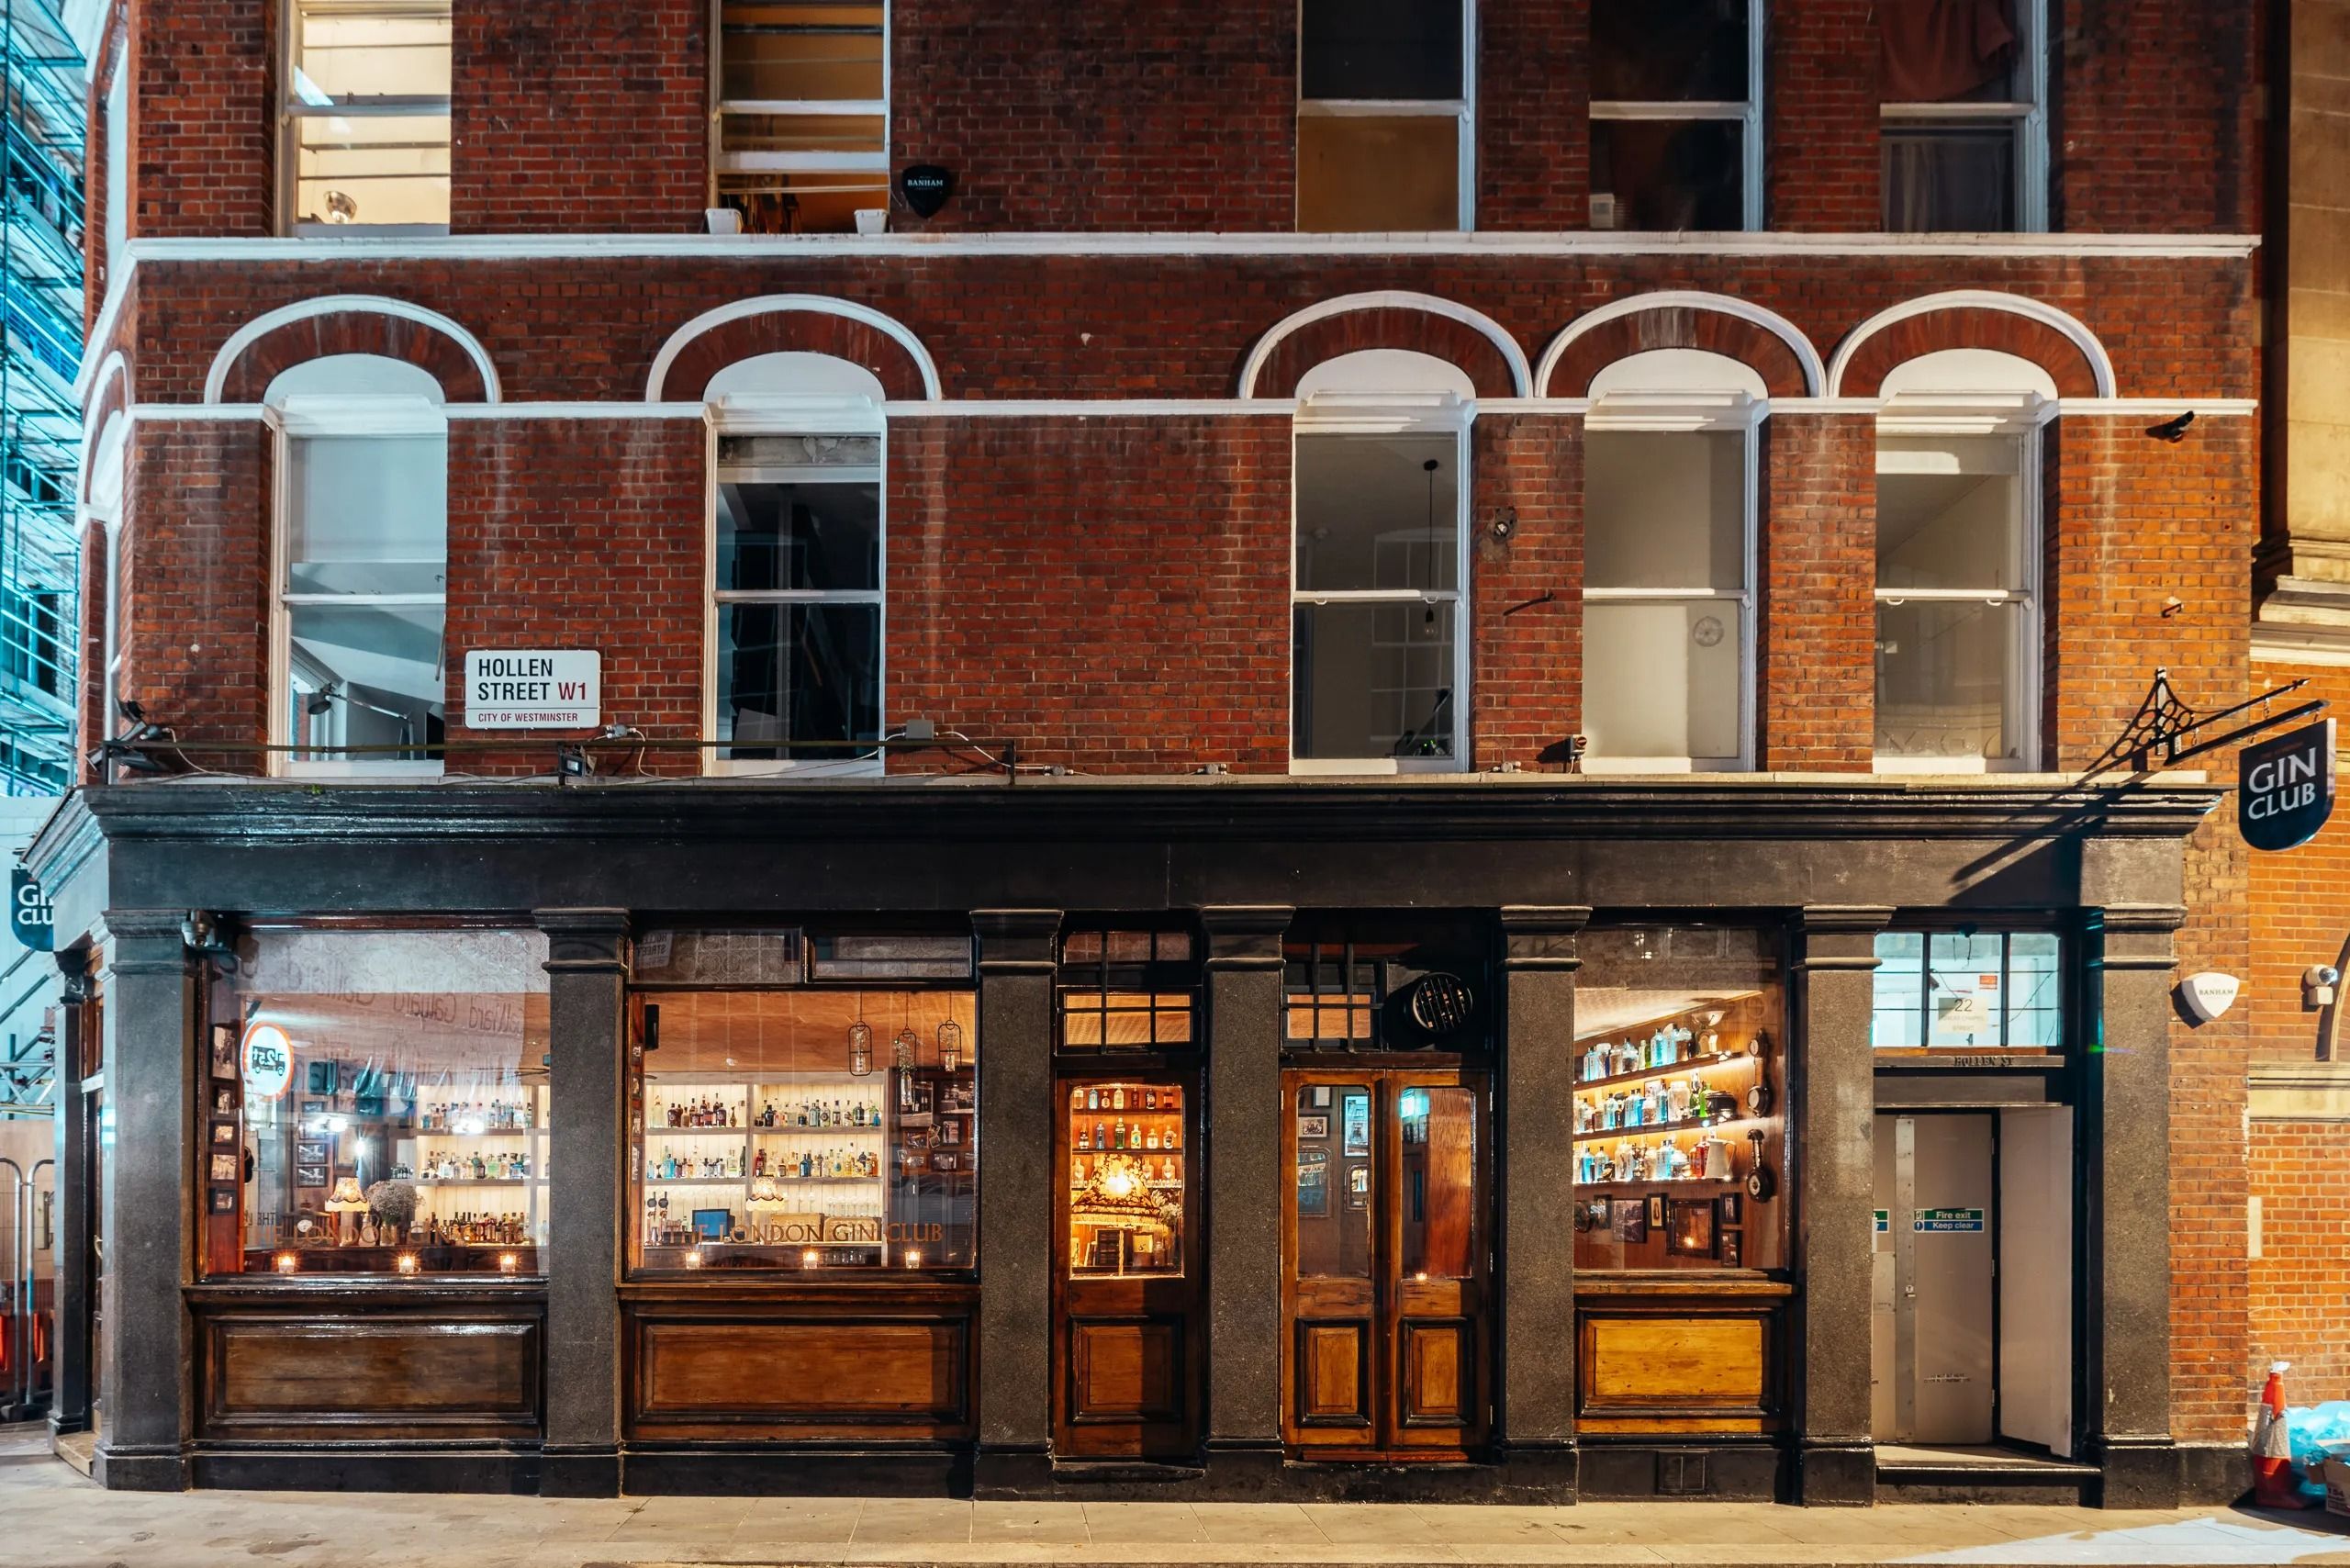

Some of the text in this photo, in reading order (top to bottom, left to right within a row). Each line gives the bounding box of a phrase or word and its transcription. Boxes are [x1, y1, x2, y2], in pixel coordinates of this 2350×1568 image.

[478, 658, 553, 677] HOLLEN
[478, 682, 587, 700] STREET W1
[478, 712, 578, 722] CITY OF WESTMINSTER
[2248, 747, 2317, 793] GIN
[2248, 782, 2316, 820] CLUB
[1954, 998, 1973, 1012] 22
[1954, 1056, 2014, 1066] HOLLEN ST
[1936, 1211, 1953, 1219] Fire
[294, 1225, 399, 1245] LONDON
[666, 1222, 944, 1244] THE LONDON GIN CLUB
[1932, 1222, 1953, 1230] Keep
